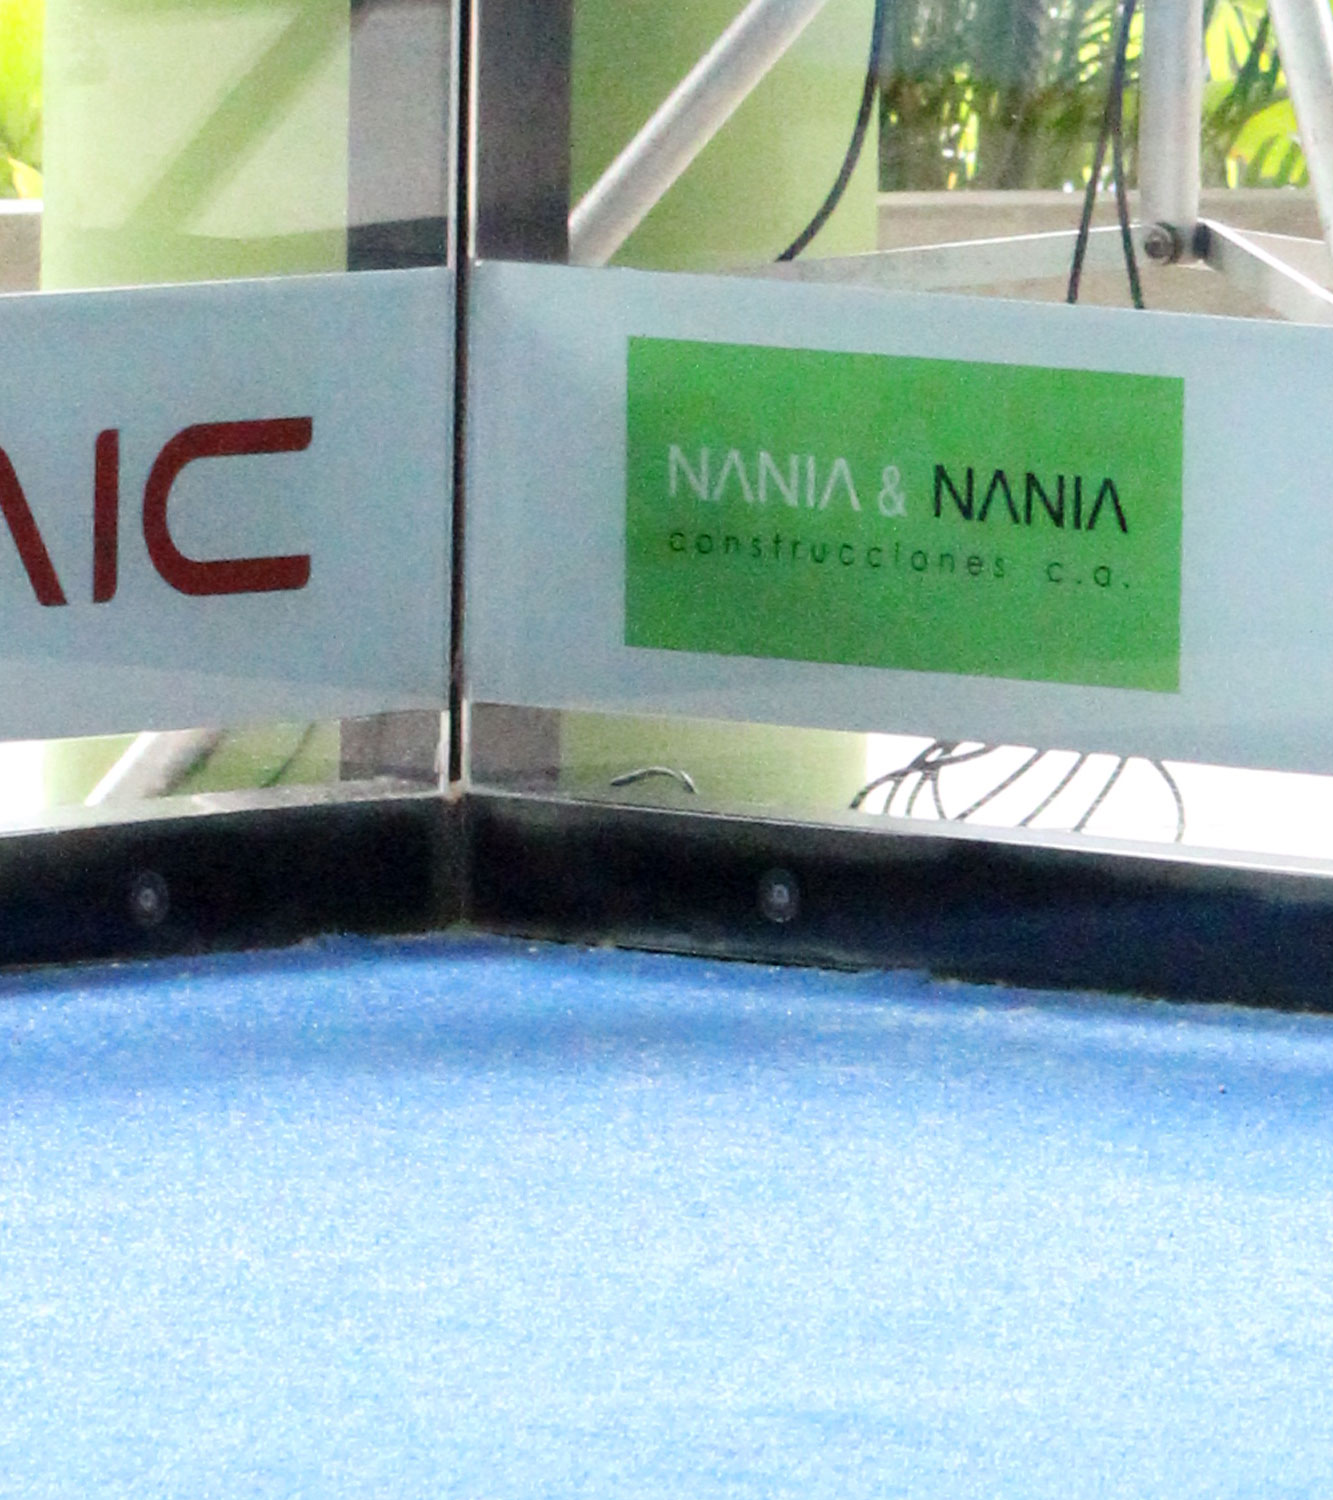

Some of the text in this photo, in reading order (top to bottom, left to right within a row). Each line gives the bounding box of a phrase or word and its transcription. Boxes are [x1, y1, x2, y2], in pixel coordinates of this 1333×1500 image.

[668, 444, 1129, 535] NANIA & NANIA
[668, 529, 1132, 589] construcciones c.a.
